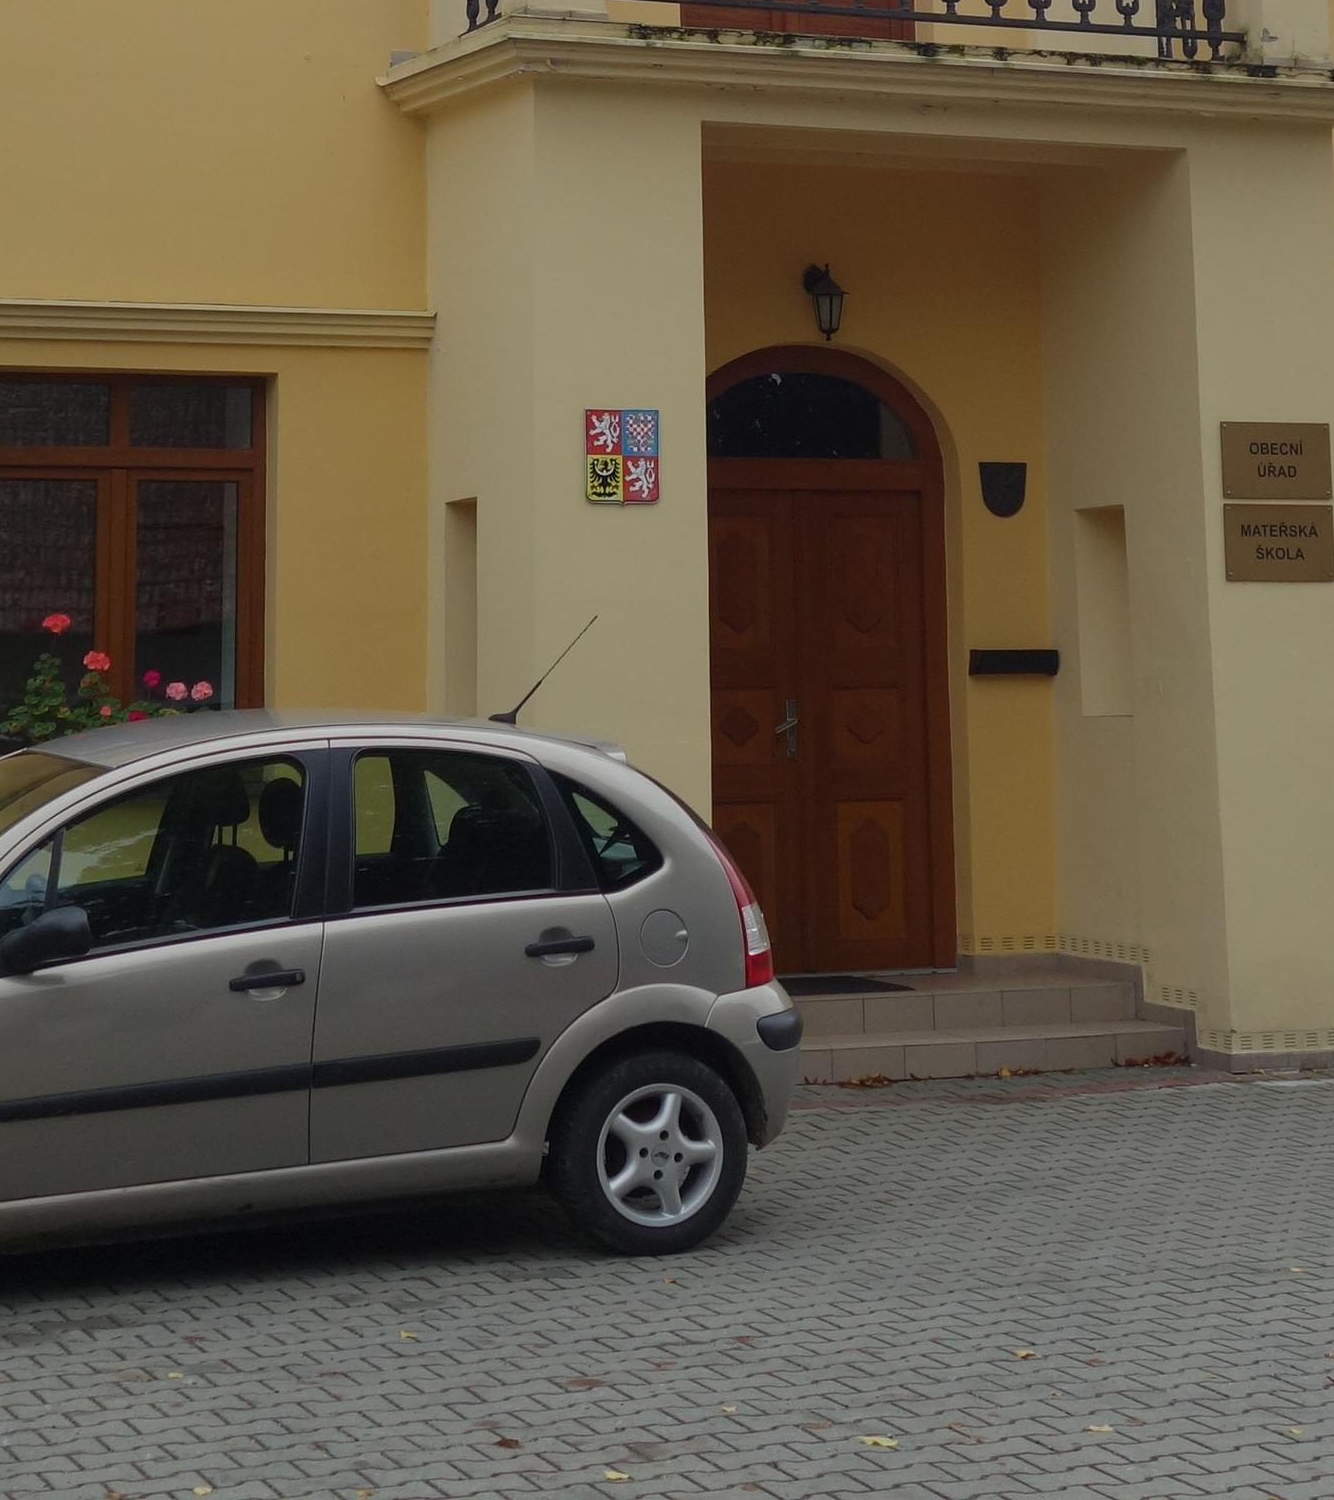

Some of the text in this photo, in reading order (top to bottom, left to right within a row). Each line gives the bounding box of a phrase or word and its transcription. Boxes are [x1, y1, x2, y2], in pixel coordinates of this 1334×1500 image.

[1249, 439, 1303, 456] OBECNÍ
[1257, 462, 1297, 478] ÚŘAD
[1241, 522, 1319, 538] MATEŘSKÁ
[1255, 545, 1305, 560] ŠKOLA
